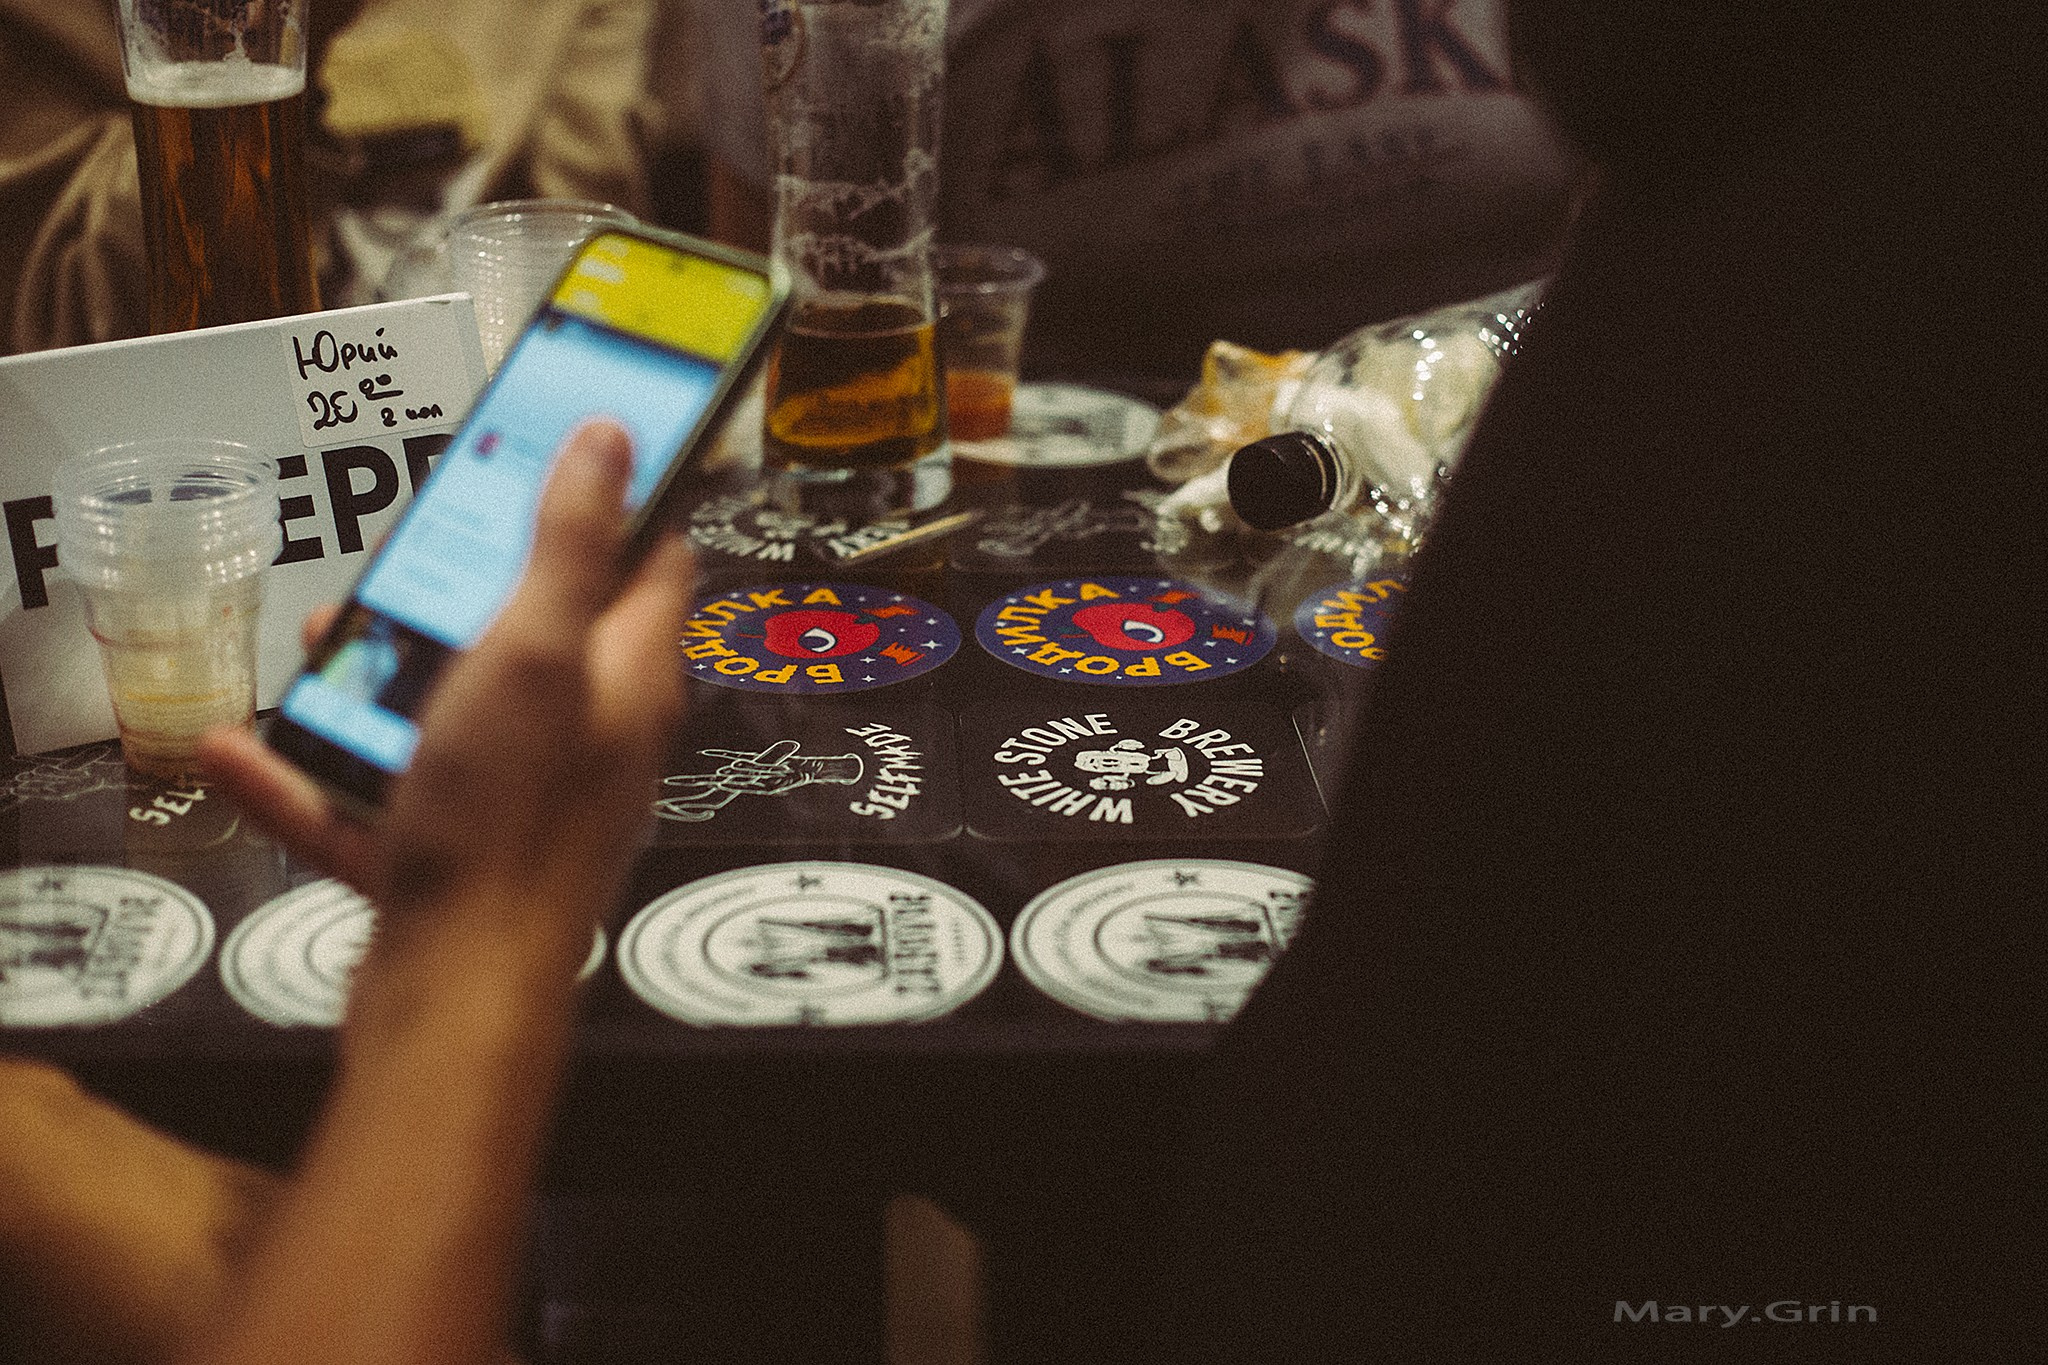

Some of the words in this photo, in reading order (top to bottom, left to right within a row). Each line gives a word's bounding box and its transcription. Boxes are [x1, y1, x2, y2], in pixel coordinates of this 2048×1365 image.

[293, 328, 398, 380] Юрий
[681, 588, 844, 684] БРОДИЛКА
[995, 583, 1212, 676] БРОДИЛКА
[843, 722, 924, 819] SELFMADE
[994, 713, 1118, 765] STONE
[1158, 718, 1264, 817] BREWERY
[998, 769, 1134, 824] WHITE
